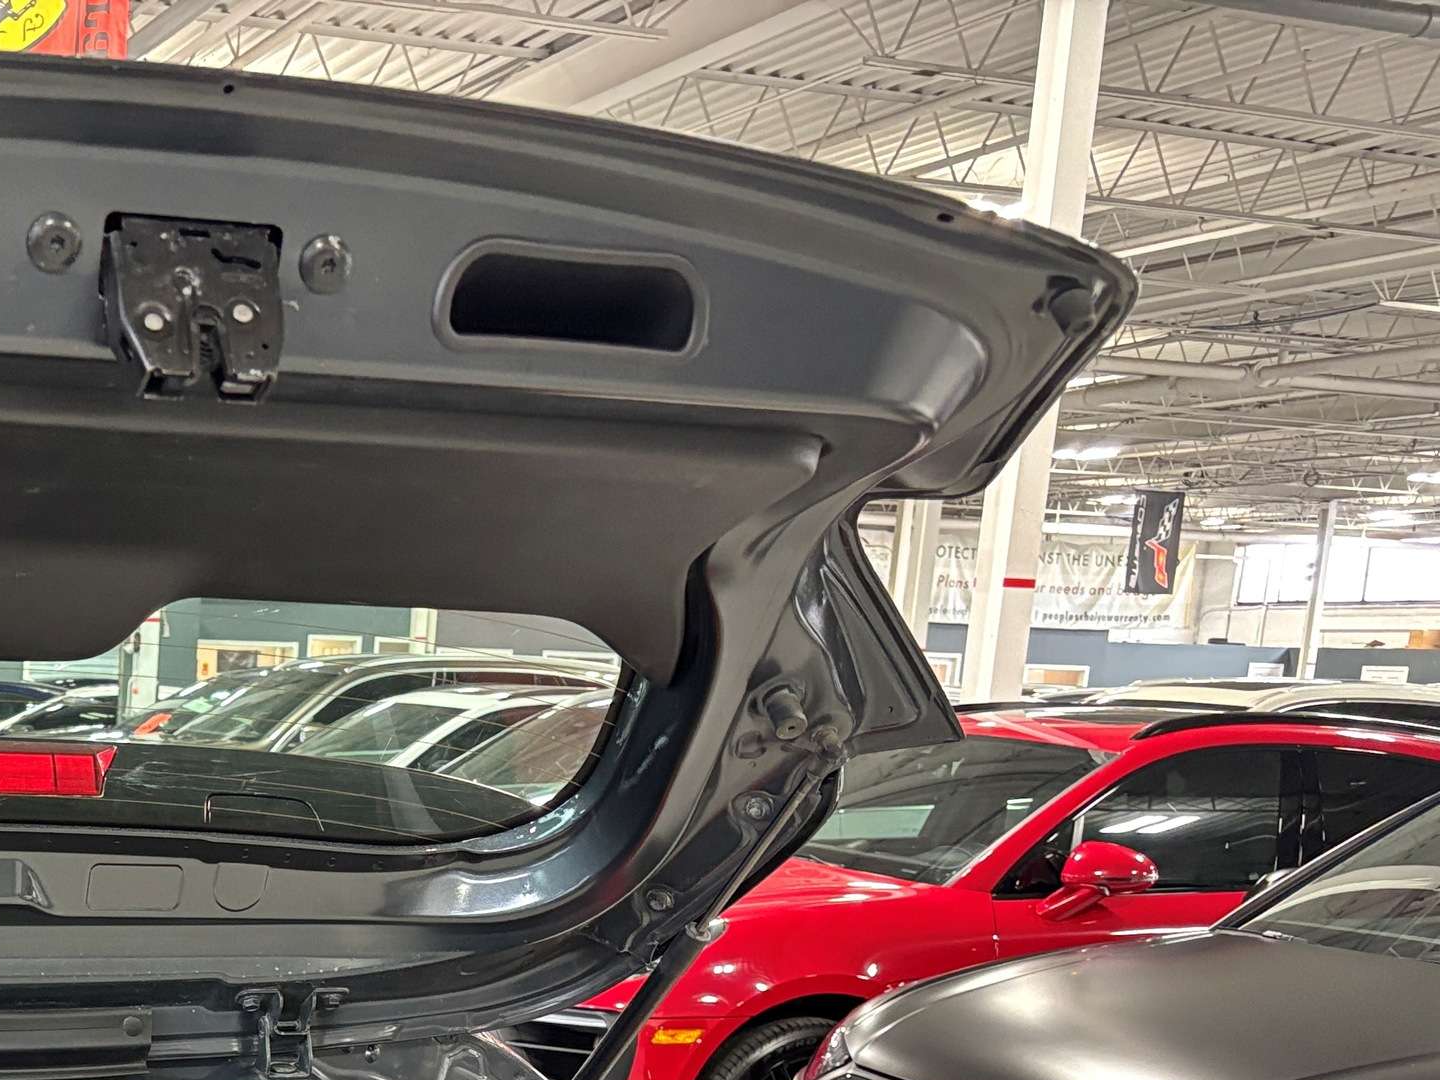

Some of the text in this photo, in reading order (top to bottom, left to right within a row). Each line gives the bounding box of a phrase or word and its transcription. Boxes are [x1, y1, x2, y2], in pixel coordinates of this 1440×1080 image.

[936, 545, 977, 560] OTECT
[1066, 551, 1090, 567] THE
[937, 574, 970, 589] Plans
